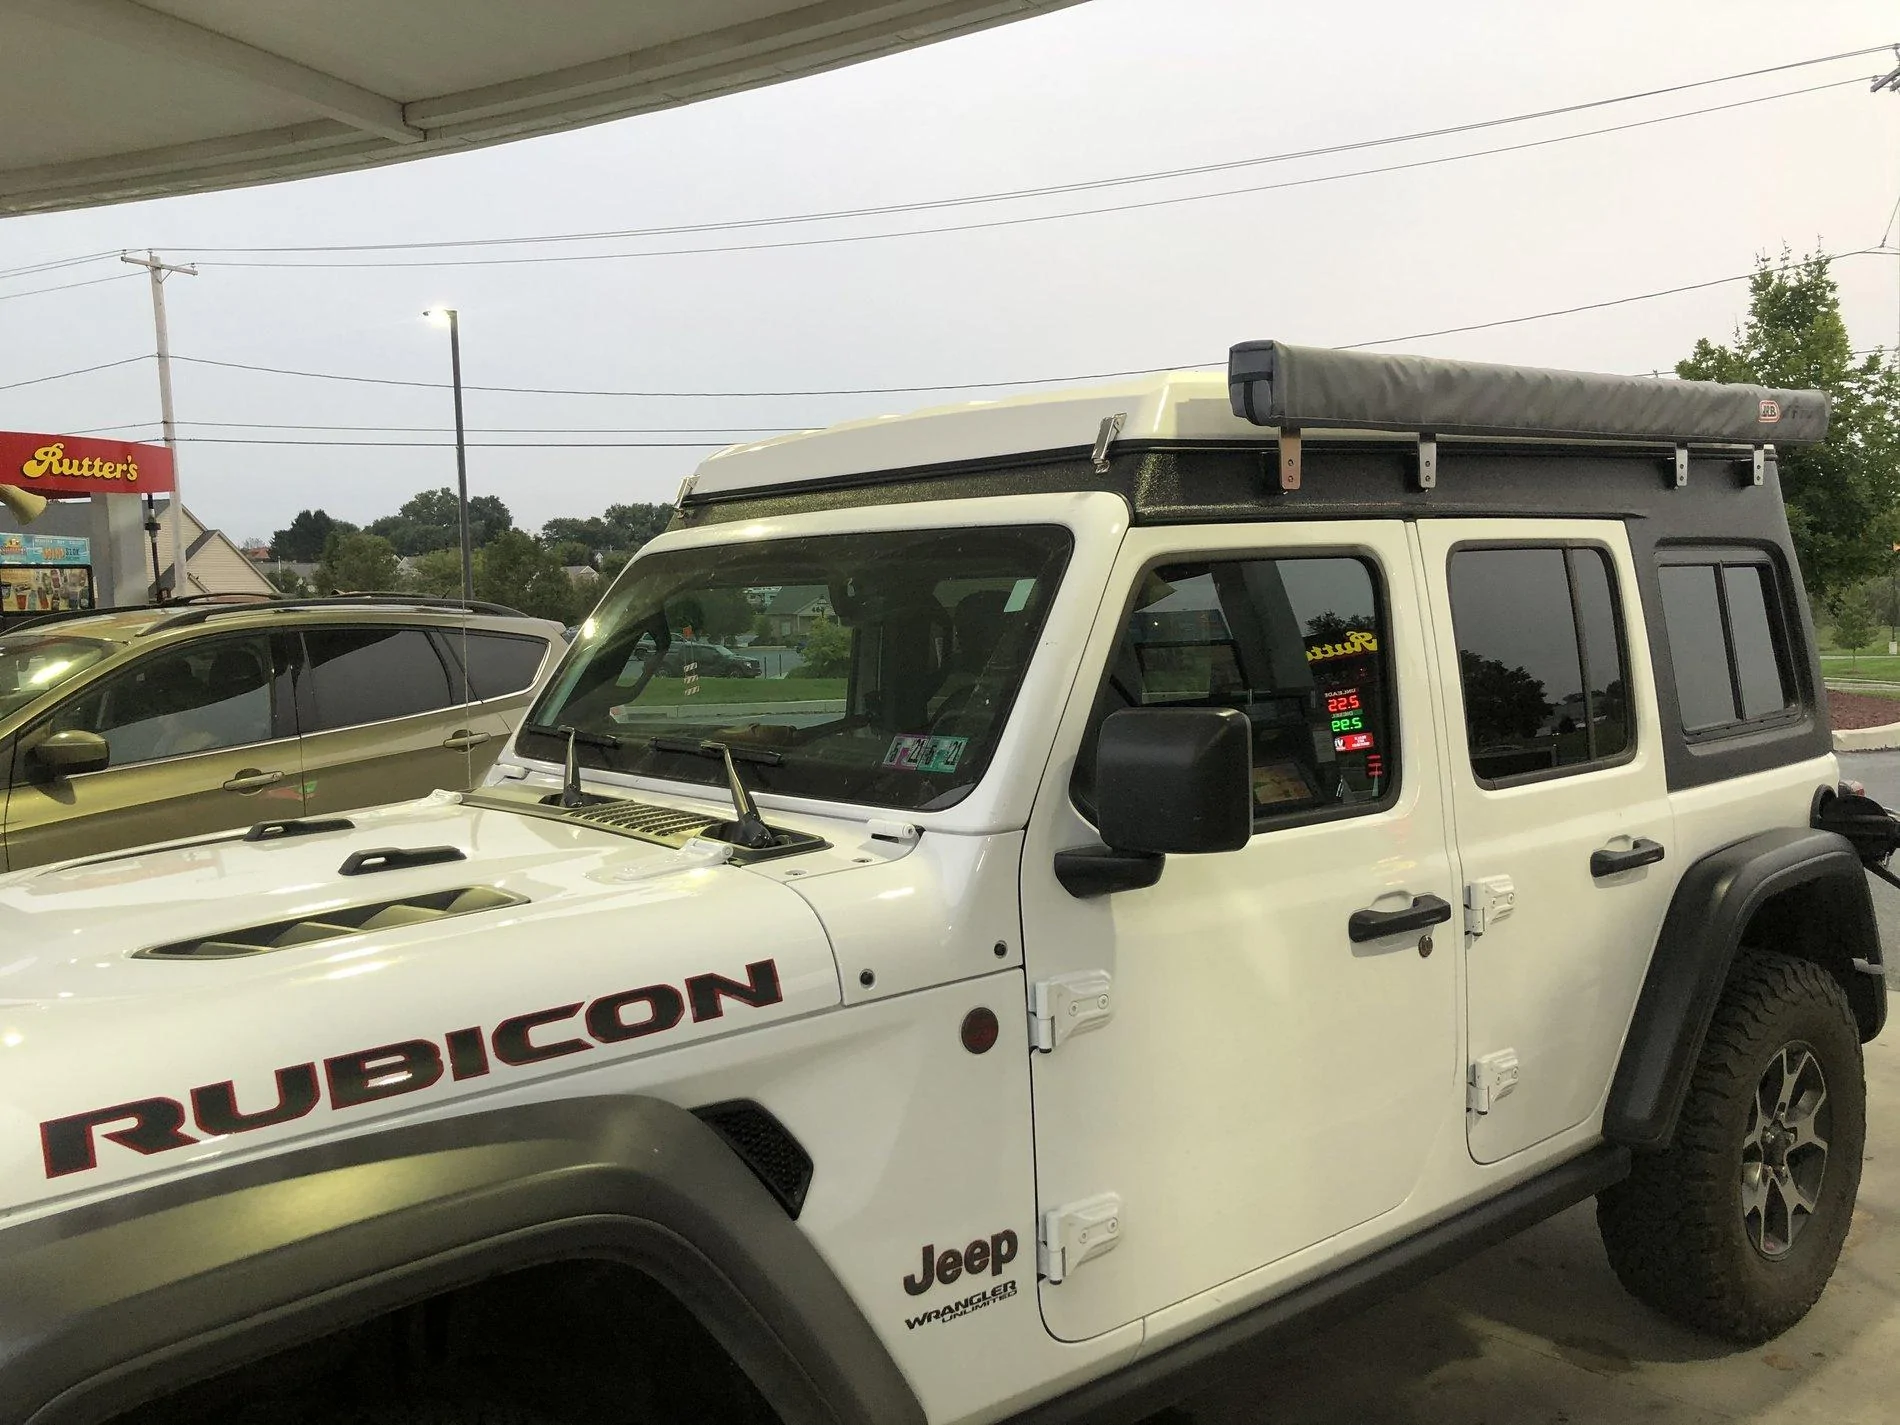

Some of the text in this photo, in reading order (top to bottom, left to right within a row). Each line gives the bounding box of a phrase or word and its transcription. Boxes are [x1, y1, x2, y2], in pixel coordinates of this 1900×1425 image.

[22, 442, 139, 482] Rutter's
[944, 740, 963, 766] 21
[39, 957, 785, 1180] RUBICON
[903, 1228, 1019, 1297] Jeep
[904, 1279, 1018, 1330] WRANGLER
[941, 1289, 1018, 1324] UNLIMITED
